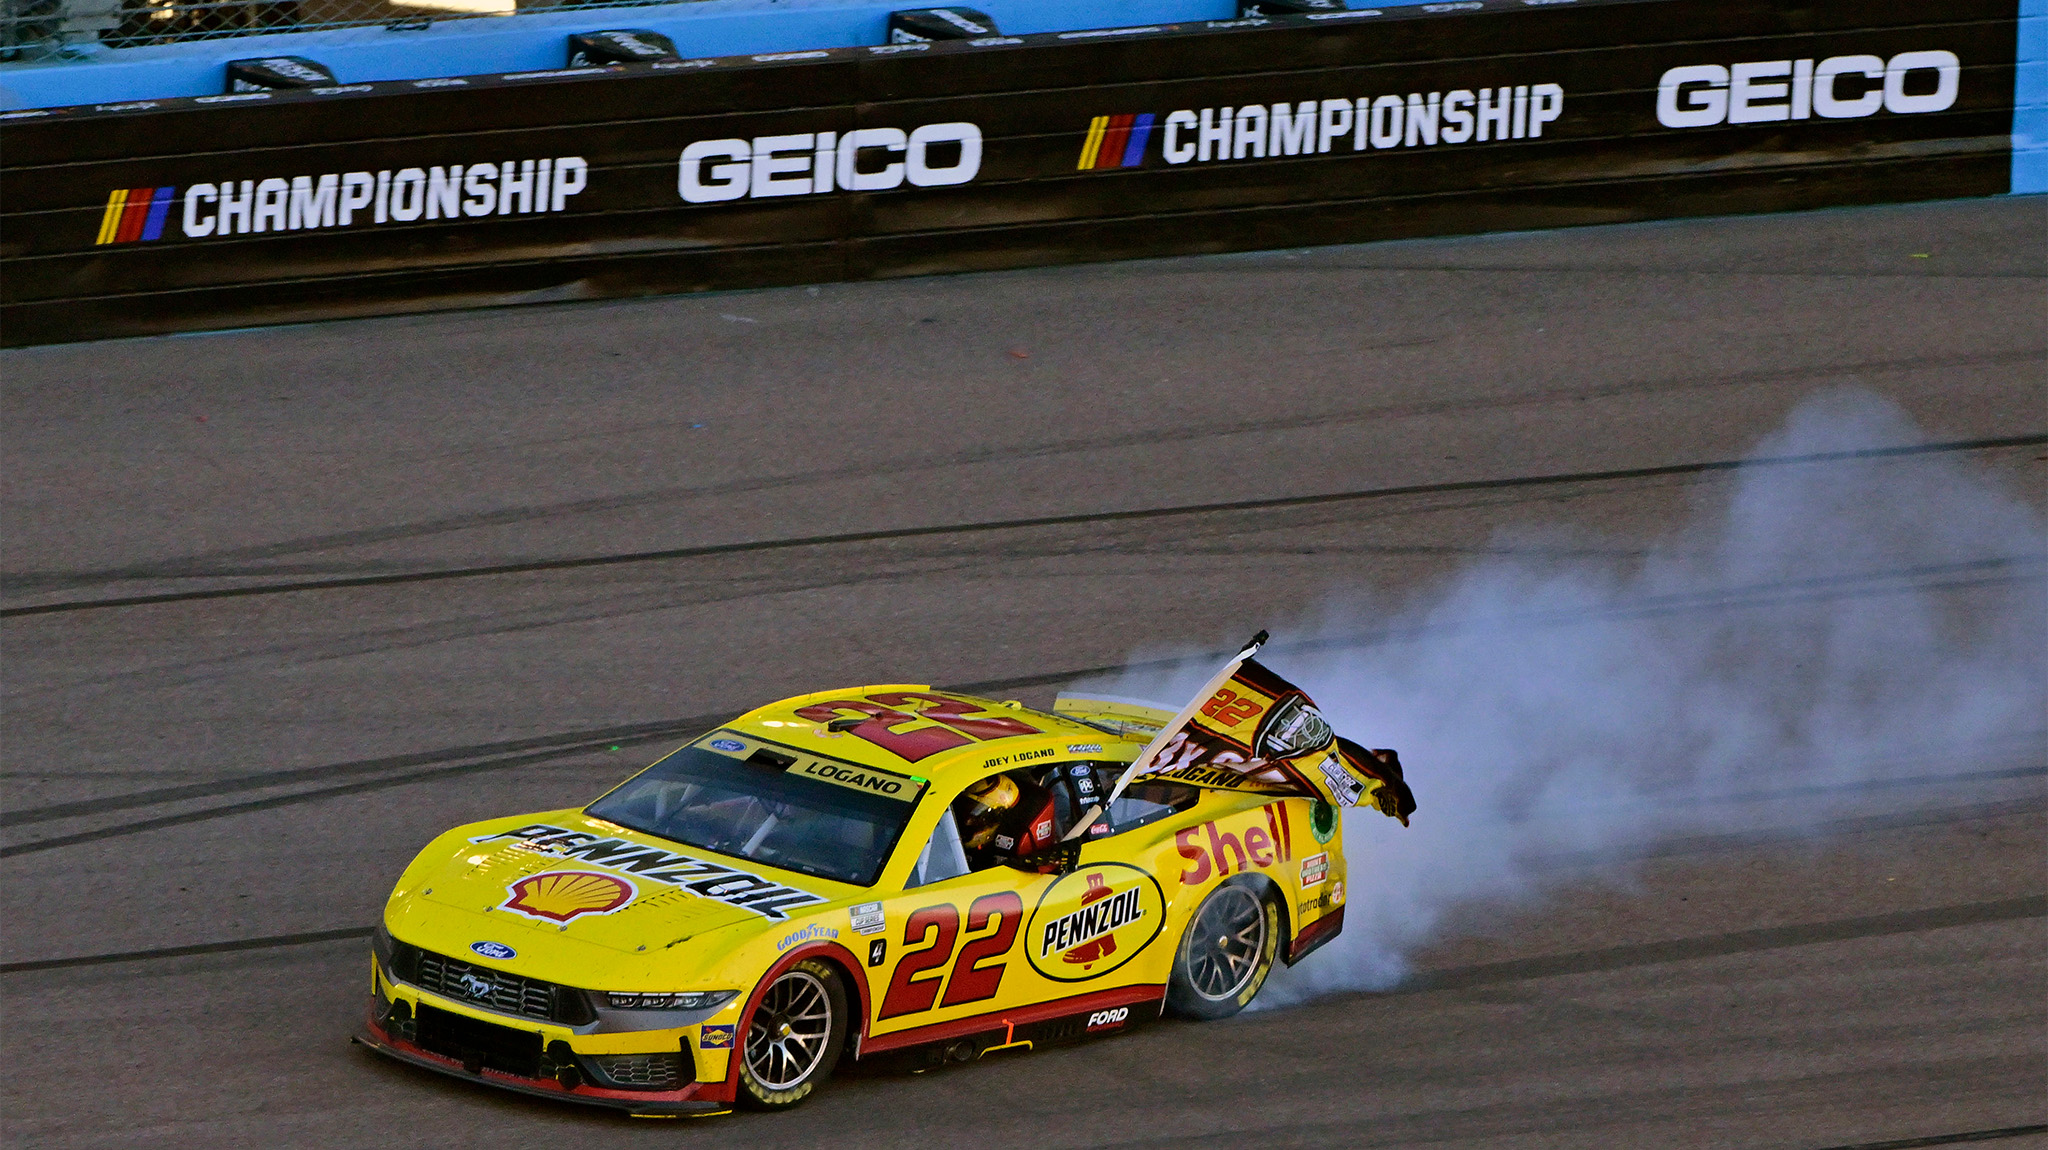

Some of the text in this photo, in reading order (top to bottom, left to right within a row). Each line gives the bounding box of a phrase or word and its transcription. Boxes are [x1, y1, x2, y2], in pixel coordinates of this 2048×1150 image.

[1162, 83, 1564, 164] CHAMPIONSHIP
[1656, 50, 1960, 129] GEICO
[182, 157, 589, 239] CHAMPIONSHIP
[678, 121, 983, 204] GEICO
[793, 692, 1046, 764] 22
[1200, 688, 1264, 727] 22
[805, 762, 902, 794] LOGANO
[983, 756, 1009, 769] JOEY
[1014, 748, 1055, 763] LOGANO
[469, 825, 828, 921] PENNZOIL
[1176, 801, 1290, 886] Shell
[872, 942, 884, 963] 4
[877, 890, 1024, 1022] 22
[1041, 886, 1143, 959] PENNZOIL
[703, 1033, 733, 1041] SUNOCO
[1088, 1007, 1129, 1027] FORD
